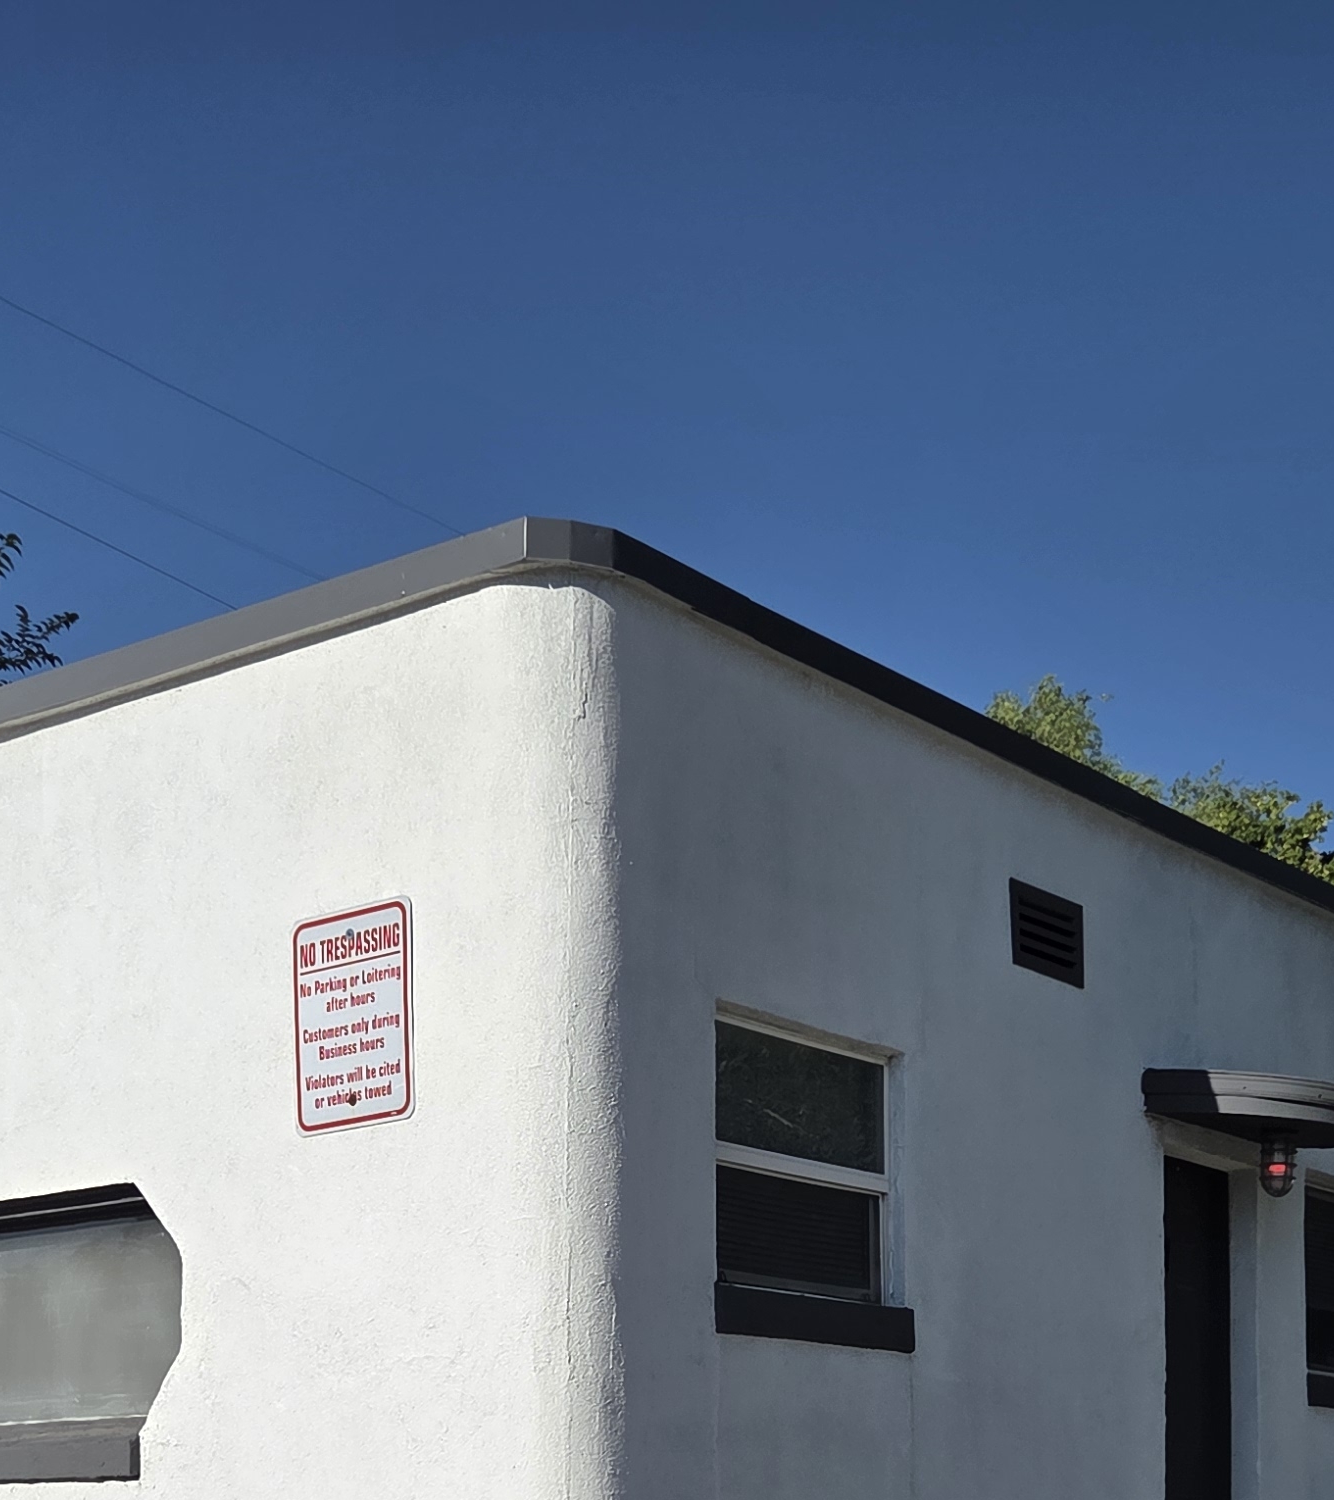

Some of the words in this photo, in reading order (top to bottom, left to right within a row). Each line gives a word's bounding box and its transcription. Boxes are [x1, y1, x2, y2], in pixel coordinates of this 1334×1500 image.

[300, 943, 315, 968] NO
[320, 923, 400, 964] TRESPASSING
[300, 983, 311, 998] No
[314, 976, 347, 995] Parking
[350, 975, 359, 987] or
[362, 964, 400, 984] Loitering
[326, 996, 348, 1012] after
[350, 992, 375, 1007] hours
[303, 1025, 349, 1044] Customers
[351, 1017, 369, 1034] only
[372, 1012, 400, 1030] during
[319, 1042, 357, 1060] Business
[360, 1037, 385, 1052] hours
[305, 1074, 344, 1091] Violators
[347, 1066, 363, 1083] will
[366, 1065, 376, 1079] be
[379, 1059, 401, 1077] cited
[315, 1097, 325, 1109] or
[365, 1080, 392, 1099] towed
